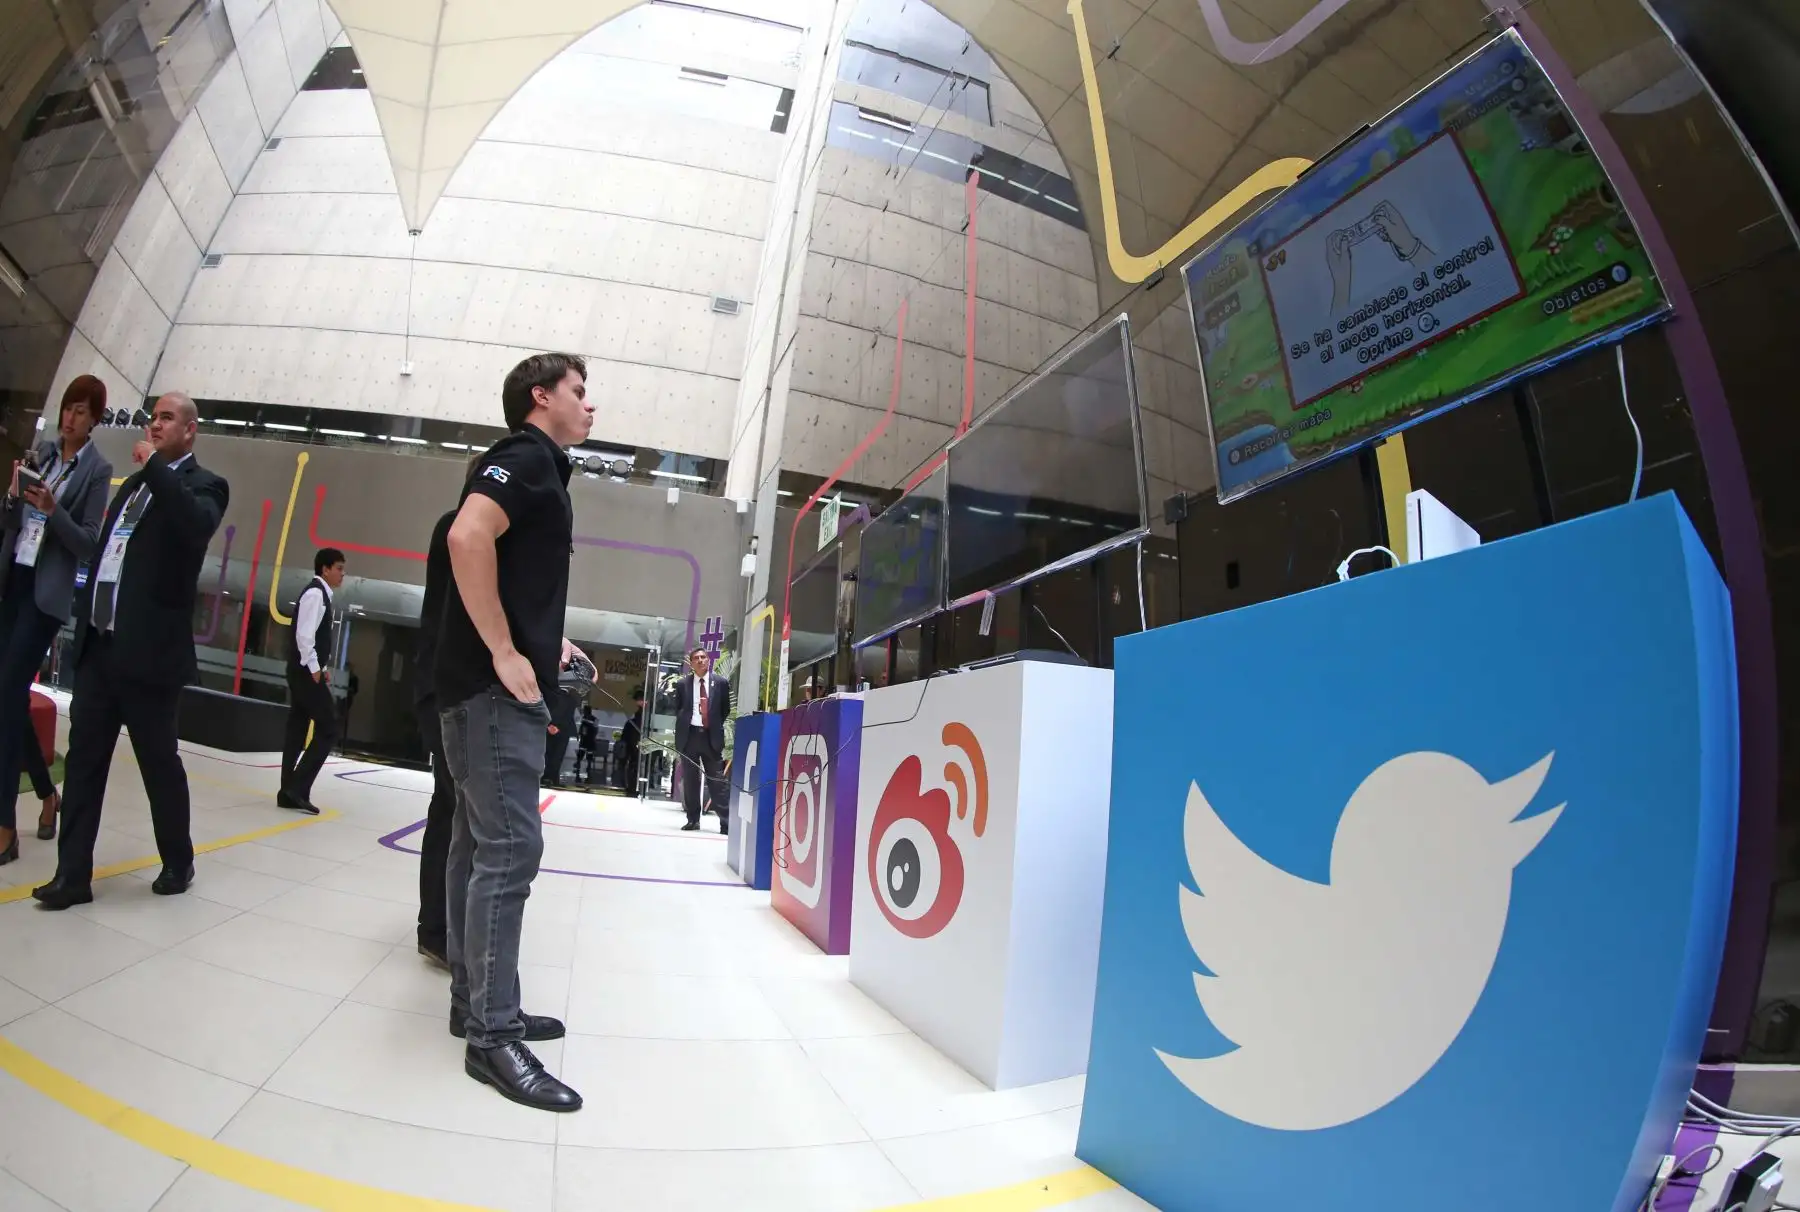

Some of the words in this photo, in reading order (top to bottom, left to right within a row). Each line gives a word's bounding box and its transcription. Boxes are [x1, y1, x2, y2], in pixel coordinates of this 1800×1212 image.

[1291, 340, 1310, 359] Se
[1314, 329, 1332, 347] ha
[1336, 286, 1408, 333] cambiado
[1413, 272, 1429, 291] el
[1433, 235, 1495, 279] control
[1320, 345, 1334, 363] al
[1338, 323, 1380, 354] modo
[1383, 274, 1472, 330] horizontal.
[1542, 278, 1607, 314] Objetos
[1356, 327, 1414, 365] Oprime
[1244, 425, 1295, 457] Recorrer
[1299, 407, 1332, 430] mapa
